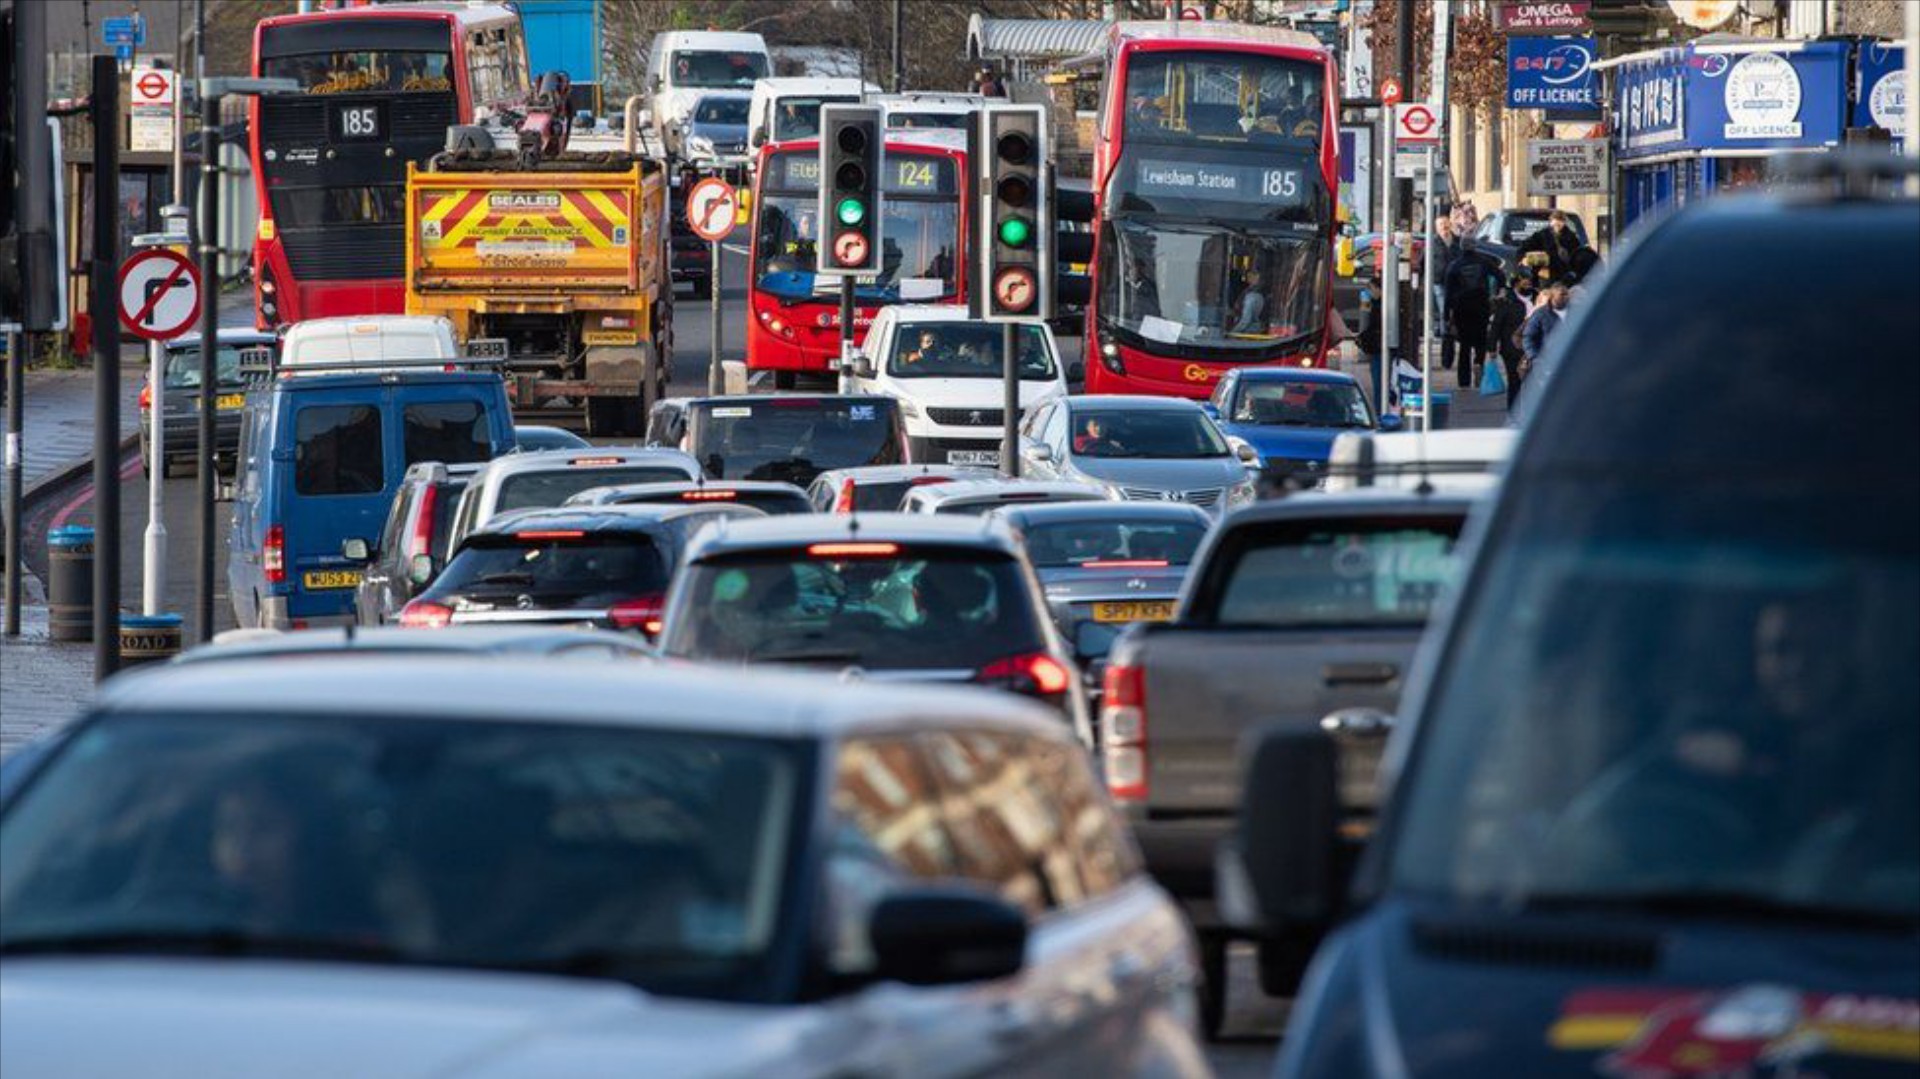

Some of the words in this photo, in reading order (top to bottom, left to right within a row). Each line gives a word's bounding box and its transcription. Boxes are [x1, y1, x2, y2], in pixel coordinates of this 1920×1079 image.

[1518, 3, 1573, 17] OMEGA
[1509, 17, 1531, 27] Sales
[1536, 17, 1542, 25] &
[1545, 16, 1583, 28] Lettings
[1515, 56, 1566, 70] 24/7
[1514, 87, 1536, 102] OFF
[1540, 87, 1591, 102] LICENCE
[343, 109, 374, 135] 185
[1728, 125, 1748, 135] OFF
[1752, 124, 1799, 135] LICENCE
[898, 162, 933, 186] 124
[1143, 167, 1195, 186] Lewisham
[1198, 170, 1236, 189] Station
[1262, 170, 1296, 196] 185
[467, 227, 509, 236] HIGHWAY
[513, 226, 582, 236] MAINTENANCE
[1184, 364, 1208, 381] Go
